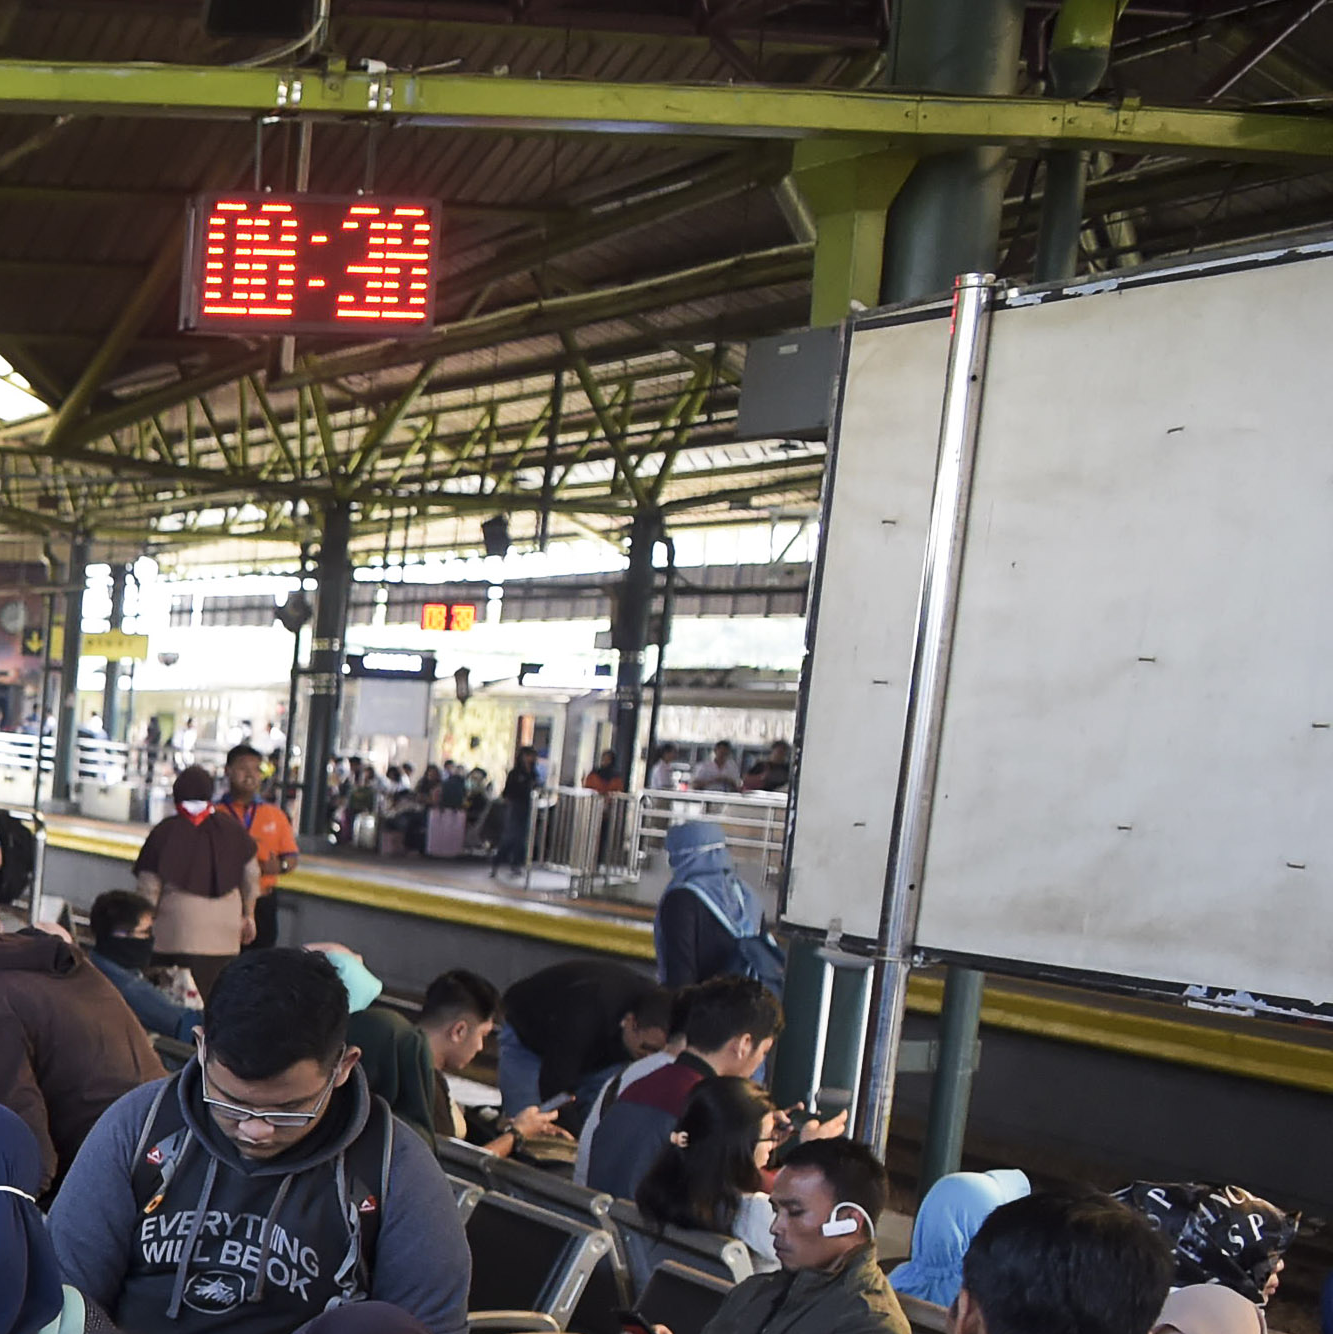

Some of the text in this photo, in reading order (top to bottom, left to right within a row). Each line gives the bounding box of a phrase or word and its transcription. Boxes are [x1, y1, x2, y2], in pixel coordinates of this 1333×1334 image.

[203, 202, 431, 319] 08:38
[141, 1210, 320, 1279] EVERYTHING
[142, 1239, 211, 1264] WILL
[219, 1239, 263, 1274] BE
[265, 1256, 313, 1303] OK
